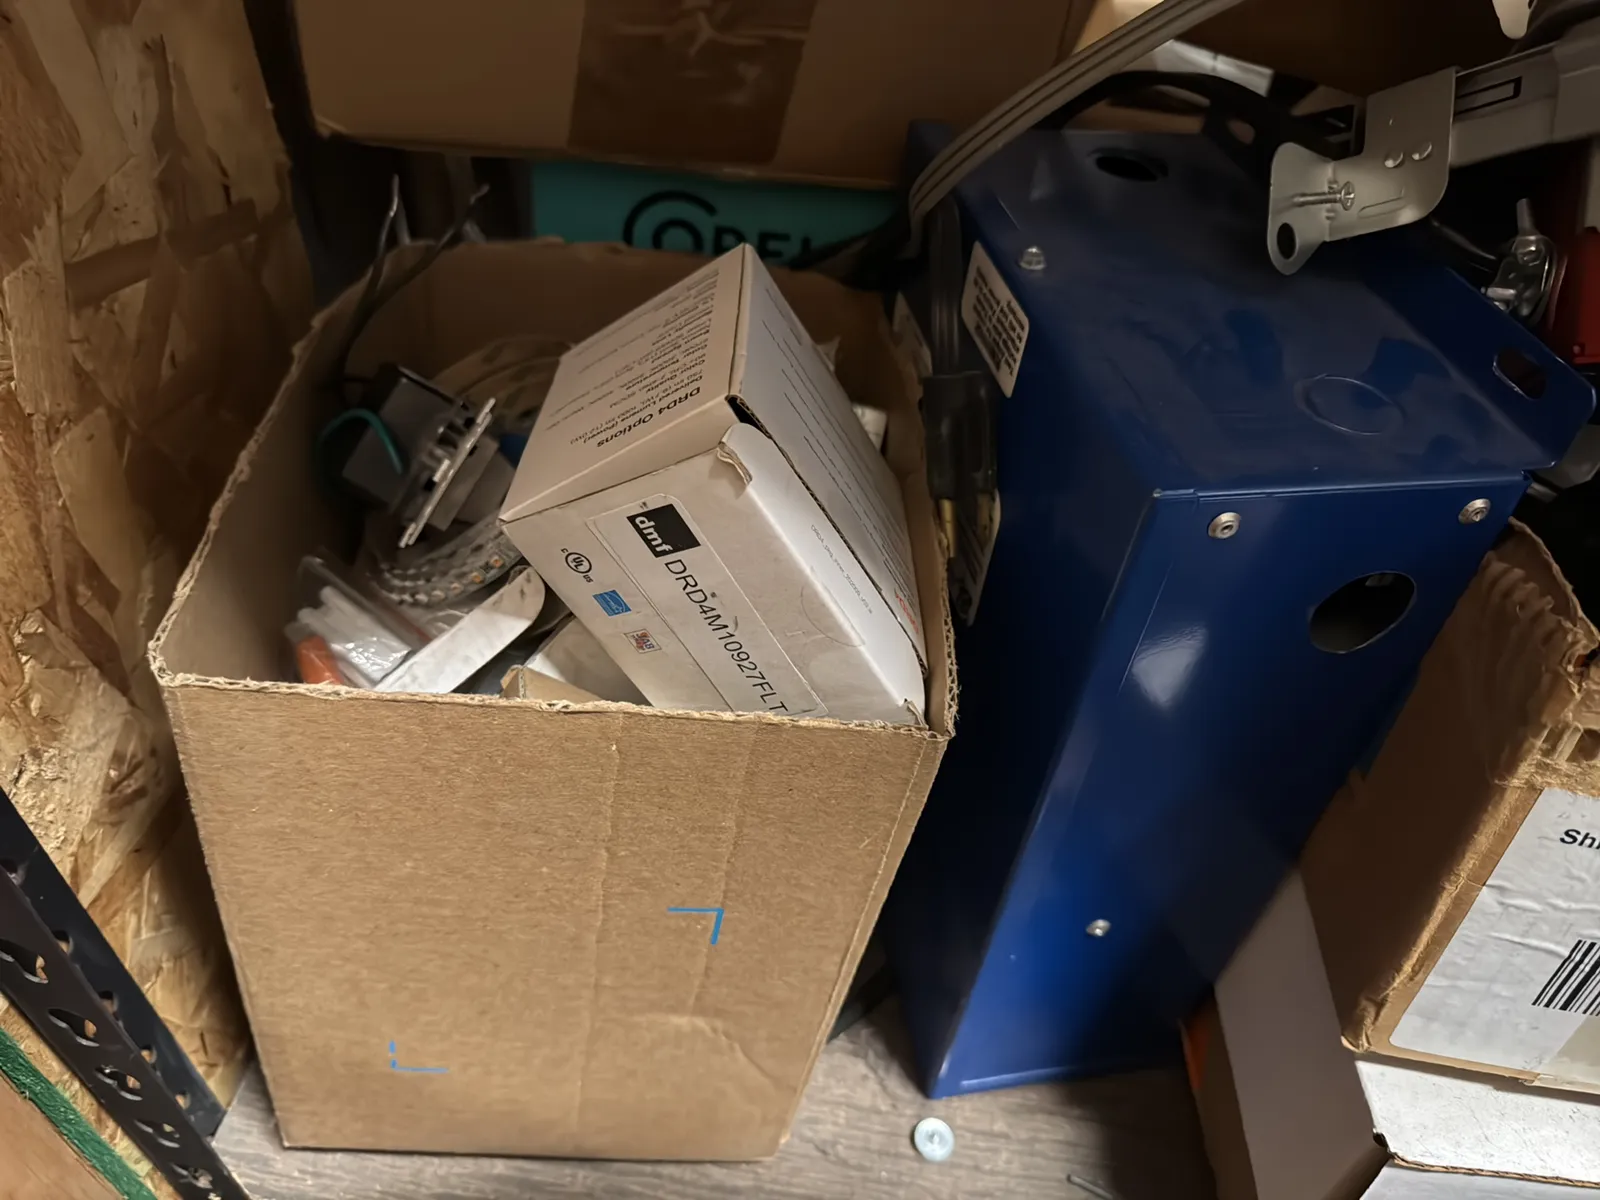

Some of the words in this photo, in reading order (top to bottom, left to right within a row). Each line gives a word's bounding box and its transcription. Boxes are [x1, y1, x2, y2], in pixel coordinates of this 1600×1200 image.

[680, 357, 704, 374] Color
[646, 373, 676, 393] Quality
[659, 375, 701, 400] Delivered
[620, 400, 655, 422] Lumens
[658, 387, 699, 414] DRD4
[583, 420, 618, 442] (Power)
[596, 413, 652, 447] Options
[635, 516, 673, 553] dmf
[664, 559, 788, 712] DRD4M10927FLT
[1560, 828, 1600, 850] Sh
